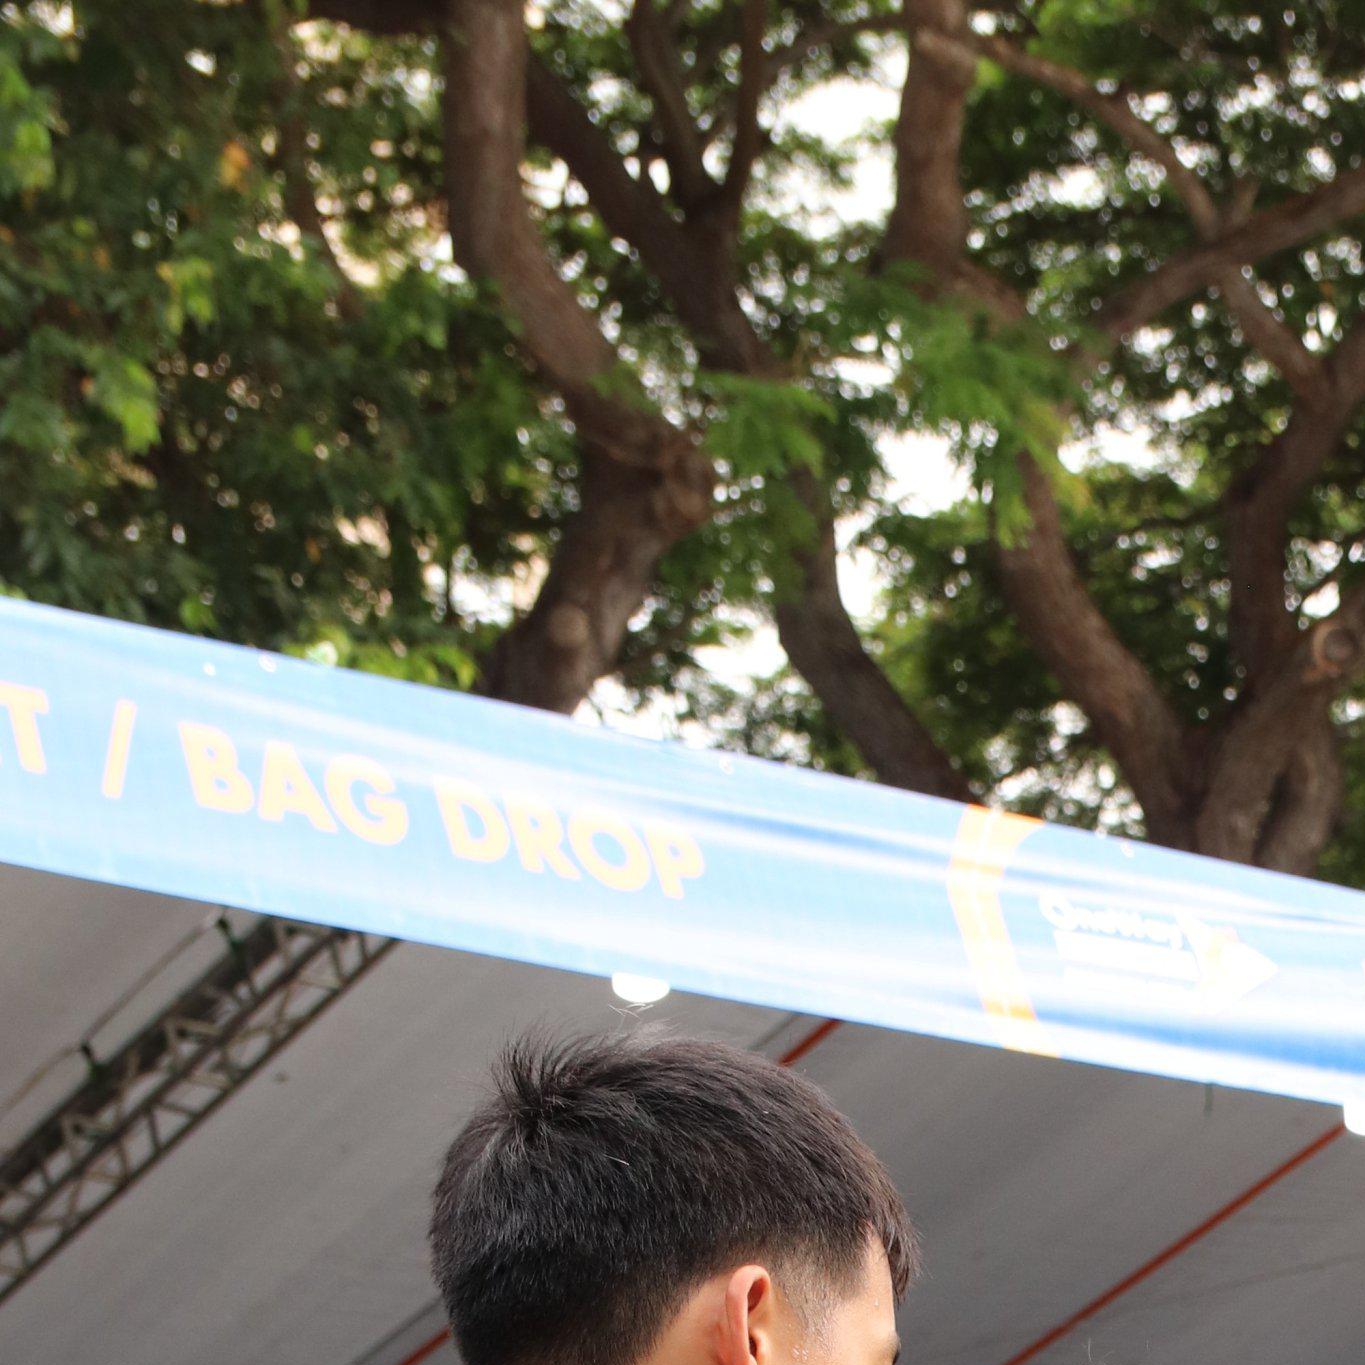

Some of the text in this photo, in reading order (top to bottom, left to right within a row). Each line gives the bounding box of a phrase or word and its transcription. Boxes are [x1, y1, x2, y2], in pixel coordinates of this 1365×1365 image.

[102, 699, 137, 799] /
[178, 721, 408, 846] BAG
[434, 773, 705, 900] DROP
